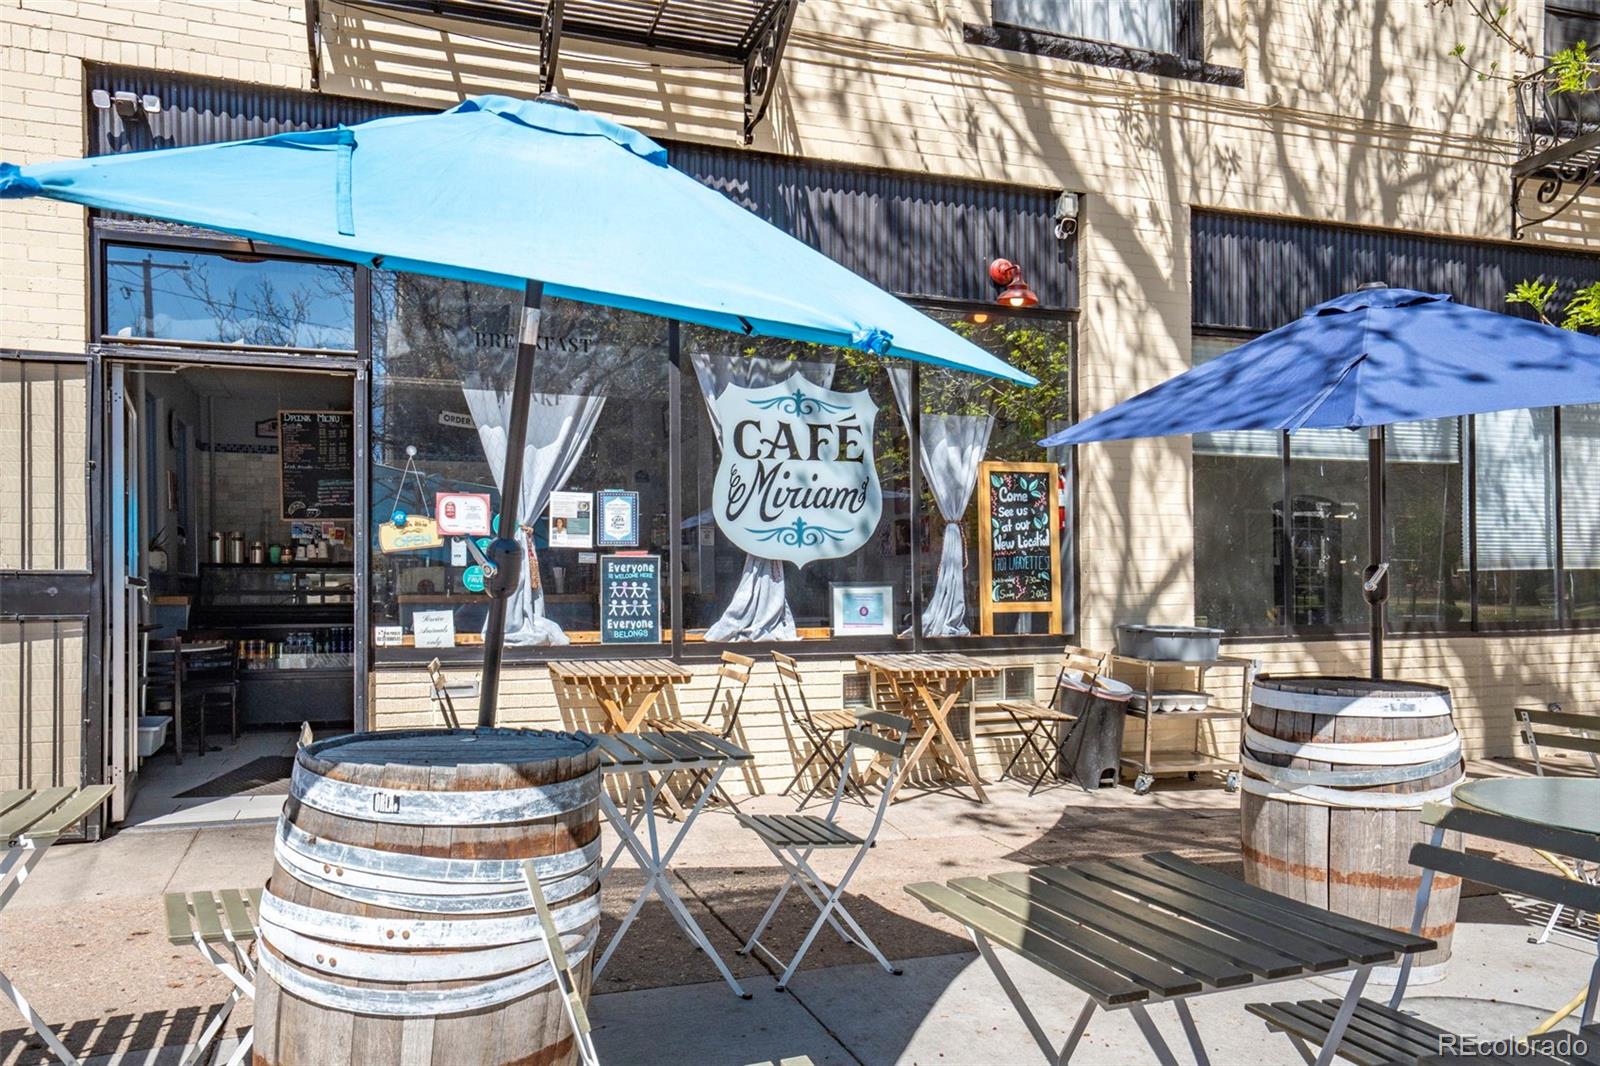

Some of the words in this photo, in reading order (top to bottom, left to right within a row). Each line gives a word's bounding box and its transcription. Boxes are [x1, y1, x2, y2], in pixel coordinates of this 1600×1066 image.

[443, 414, 471, 425] ORDER
[733, 413, 865, 464] CAFÉ
[725, 459, 870, 523] Miriam
[999, 486, 1029, 503] Come
[998, 506, 1014, 517] See
[1016, 507, 1028, 516] us
[1001, 519, 1013, 532] at
[1015, 520, 1031, 531] our
[994, 534, 1015, 551] New
[1017, 528, 1050, 549] Location
[608, 562, 655, 573] Everyone
[607, 619, 654, 629] Everyone
[613, 629, 649, 638] BELONGS
